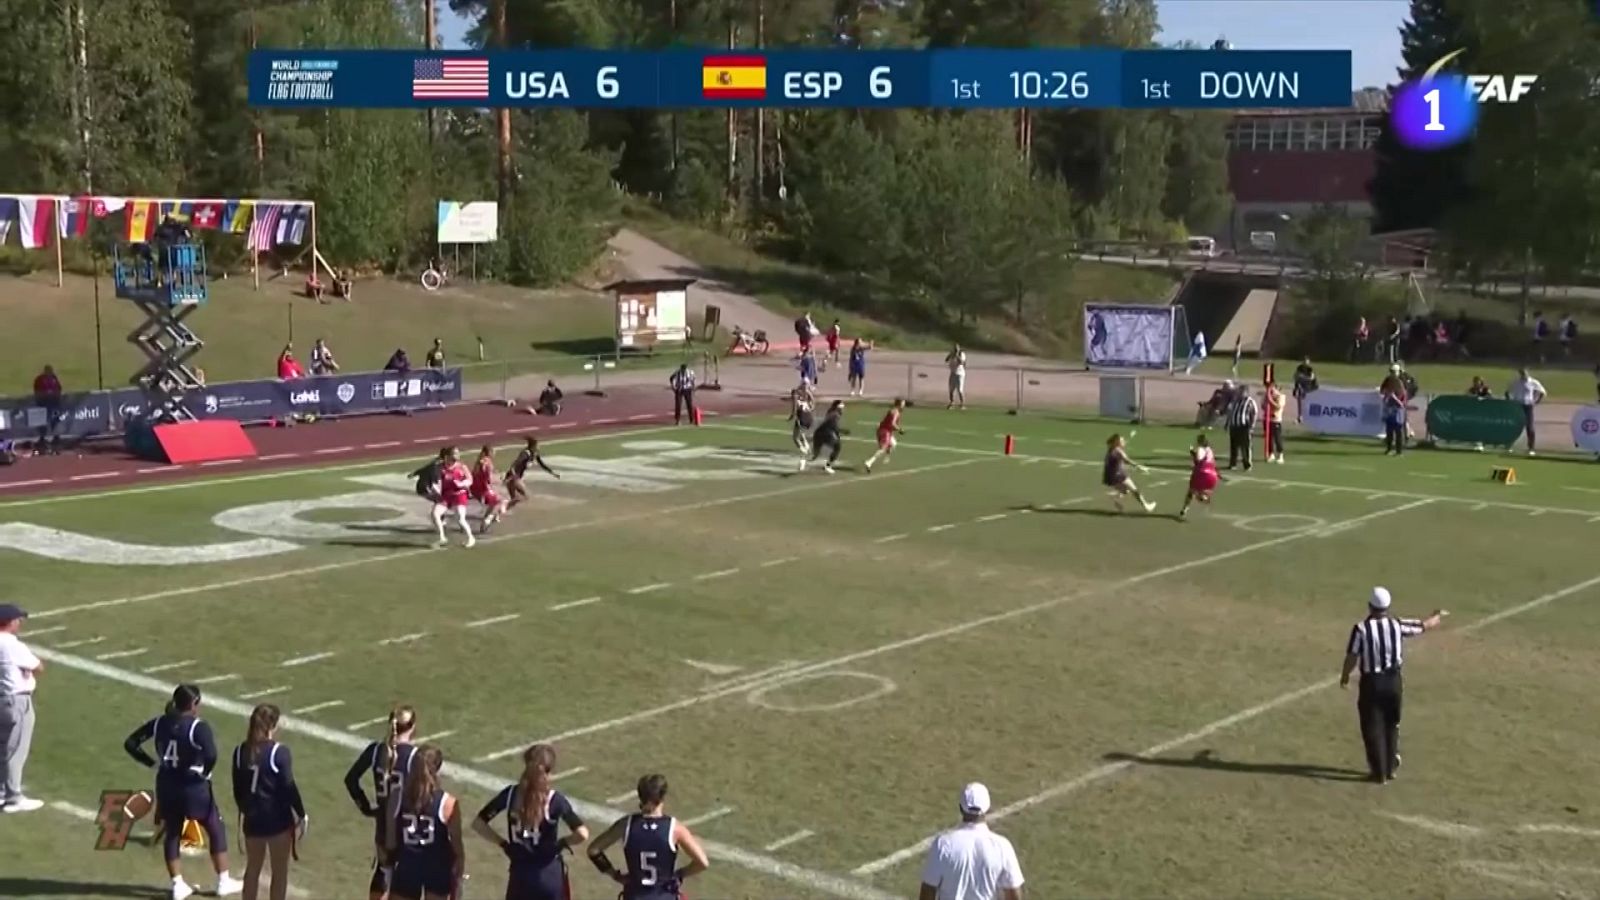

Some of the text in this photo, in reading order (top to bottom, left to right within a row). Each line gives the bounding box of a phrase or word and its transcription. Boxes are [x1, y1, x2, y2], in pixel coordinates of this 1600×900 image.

[290, 389, 320, 405] Lahti
[163, 741, 178, 767] 4
[402, 814, 434, 845] 23
[640, 851, 657, 885] 5
